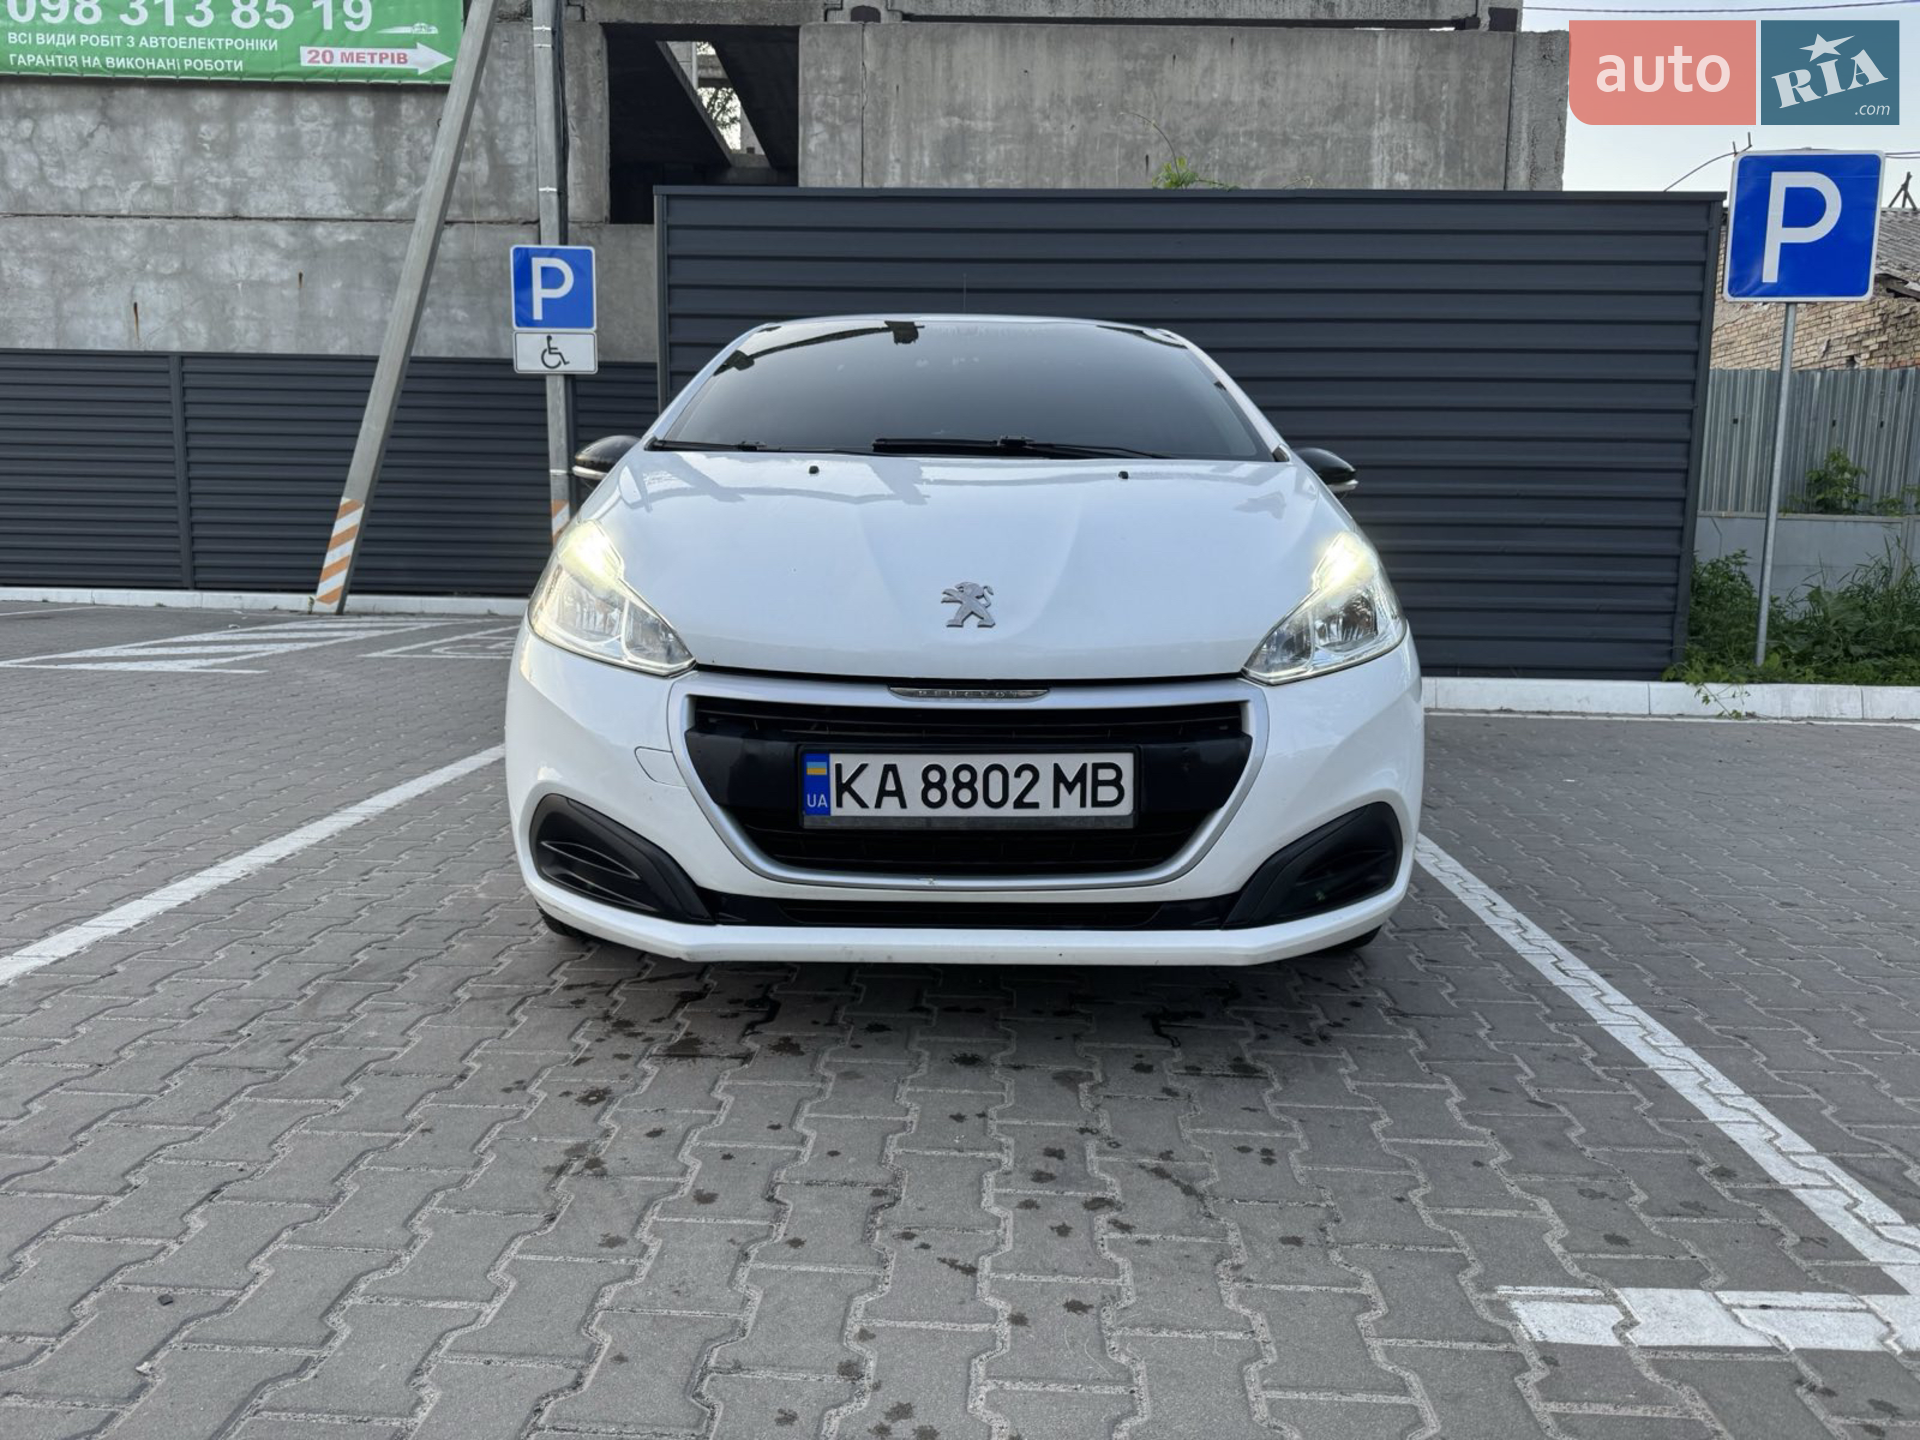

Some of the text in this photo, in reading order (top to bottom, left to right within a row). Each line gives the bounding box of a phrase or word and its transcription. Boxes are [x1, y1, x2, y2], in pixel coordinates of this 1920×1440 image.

[7, 0, 373, 32] 098 313 85 19
[8, 32, 32, 45] ВСІ
[36, 33, 76, 48] ВИДИ
[80, 34, 122, 47] РОБІТ
[139, 36, 278, 51] АВТОЕЛЕКТРОНІКИ
[9, 53, 244, 72] ГАРАНТІЯ НА ВИКОНАНІ РОБОТИ
[307, 49, 408, 65] 20 МЕТРІВ
[1762, 171, 1842, 283] P
[531, 257, 575, 320] P
[835, 762, 1126, 809] KA 8802 MB
[807, 794, 828, 808] UA
